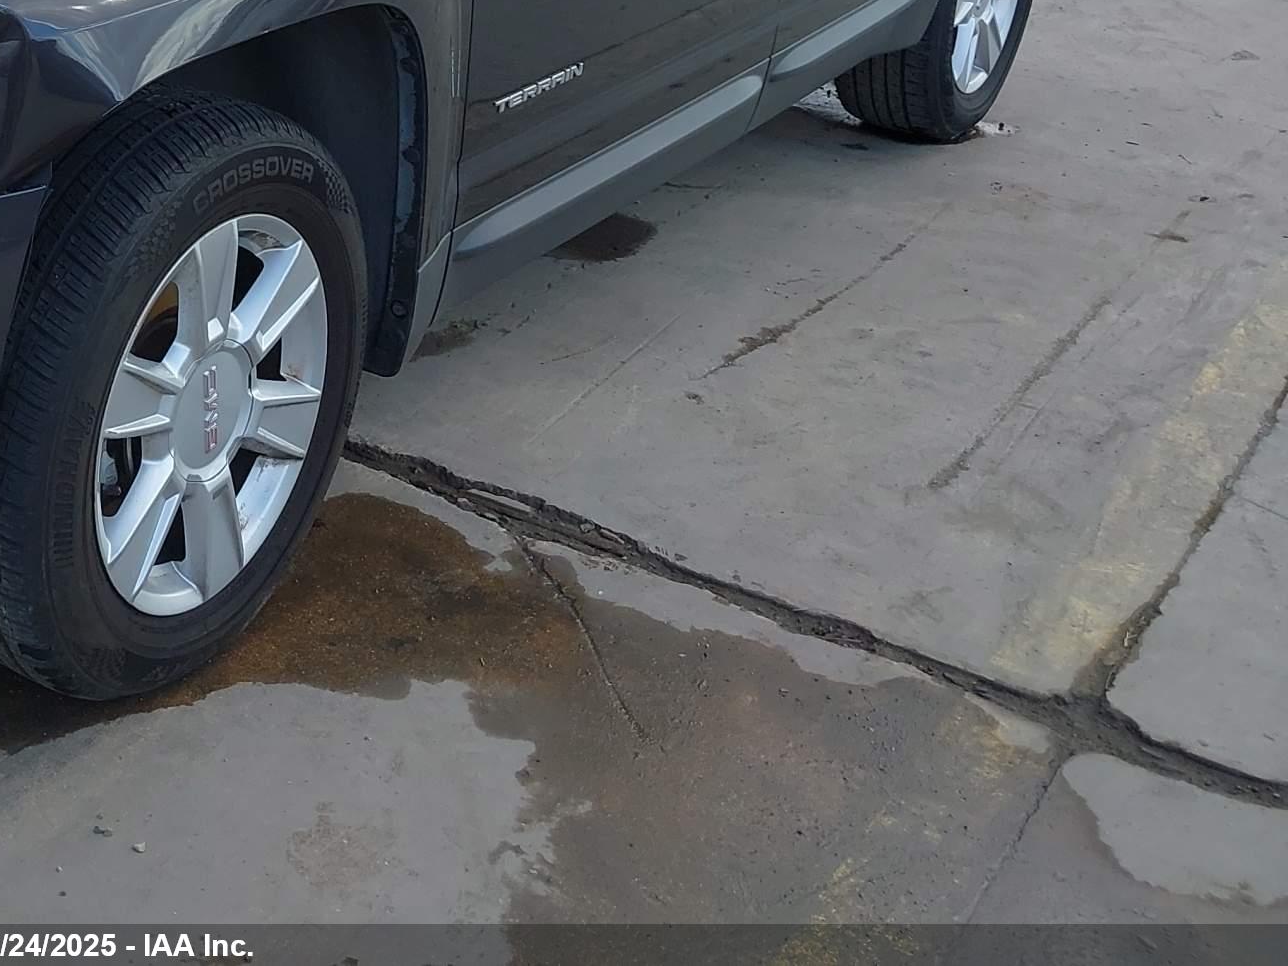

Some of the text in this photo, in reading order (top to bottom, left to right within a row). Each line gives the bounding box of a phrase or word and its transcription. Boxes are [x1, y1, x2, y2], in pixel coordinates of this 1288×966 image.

[495, 62, 584, 113] TERRAIN
[192, 156, 314, 214] CROSSOVER
[203, 366, 218, 454] GMC
